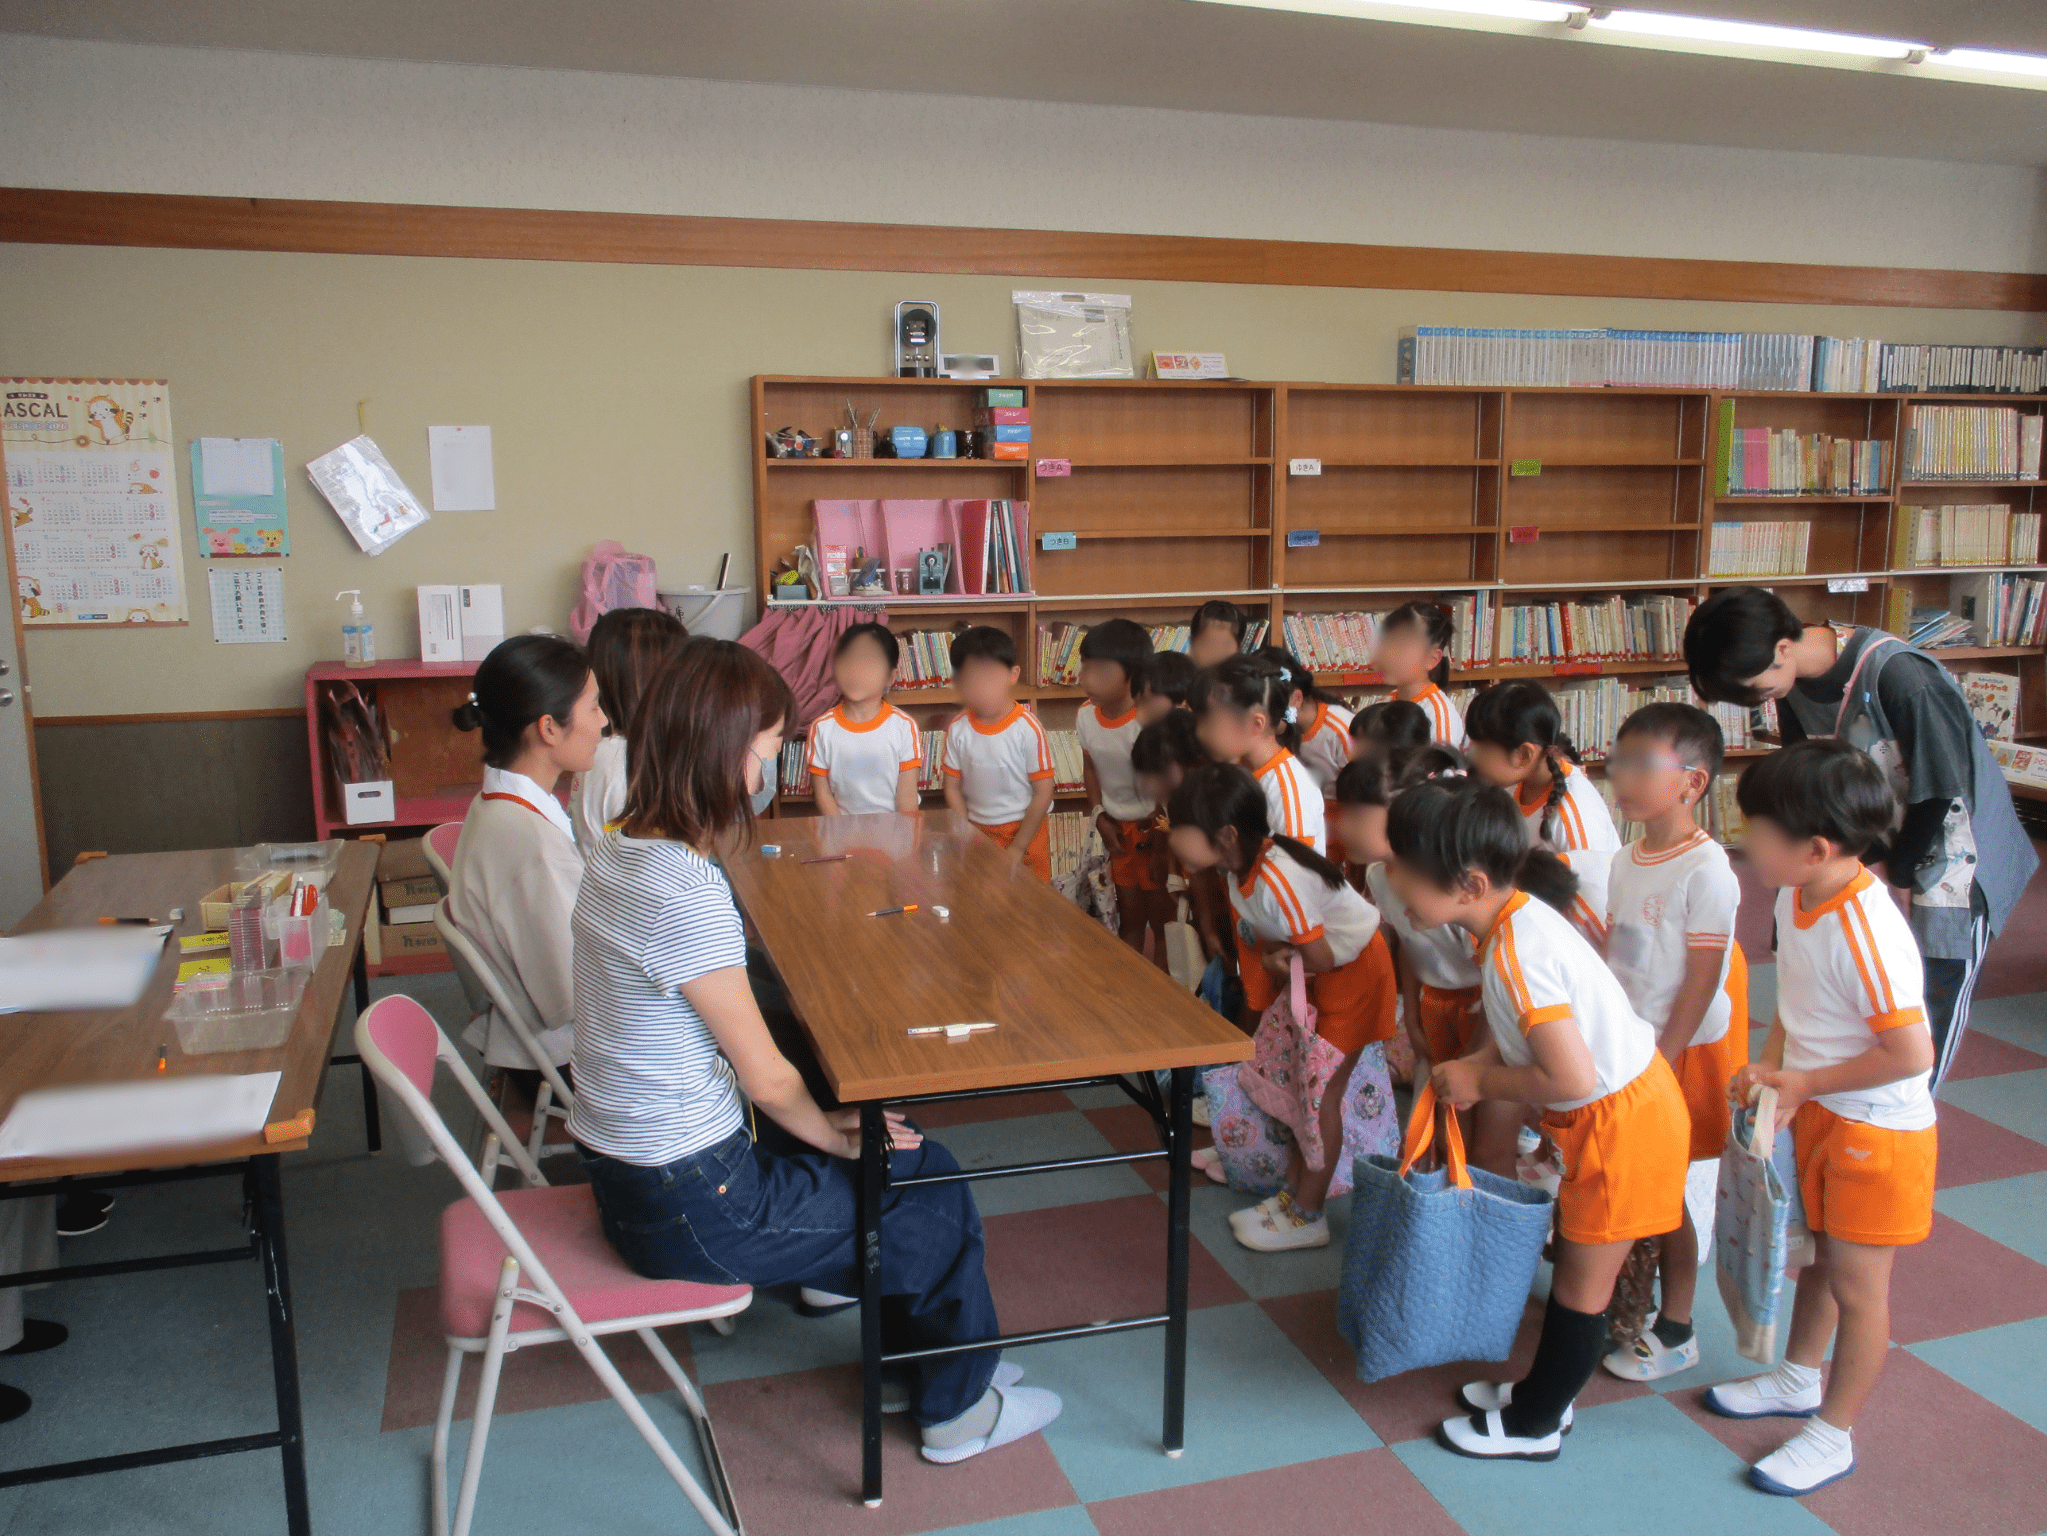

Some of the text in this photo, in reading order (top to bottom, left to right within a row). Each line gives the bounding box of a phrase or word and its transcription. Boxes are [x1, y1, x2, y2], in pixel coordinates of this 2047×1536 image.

[0, 402, 69, 418] ASCAL
[1038, 462, 1063, 473] つきA
[1050, 537, 1070, 546] つきB
